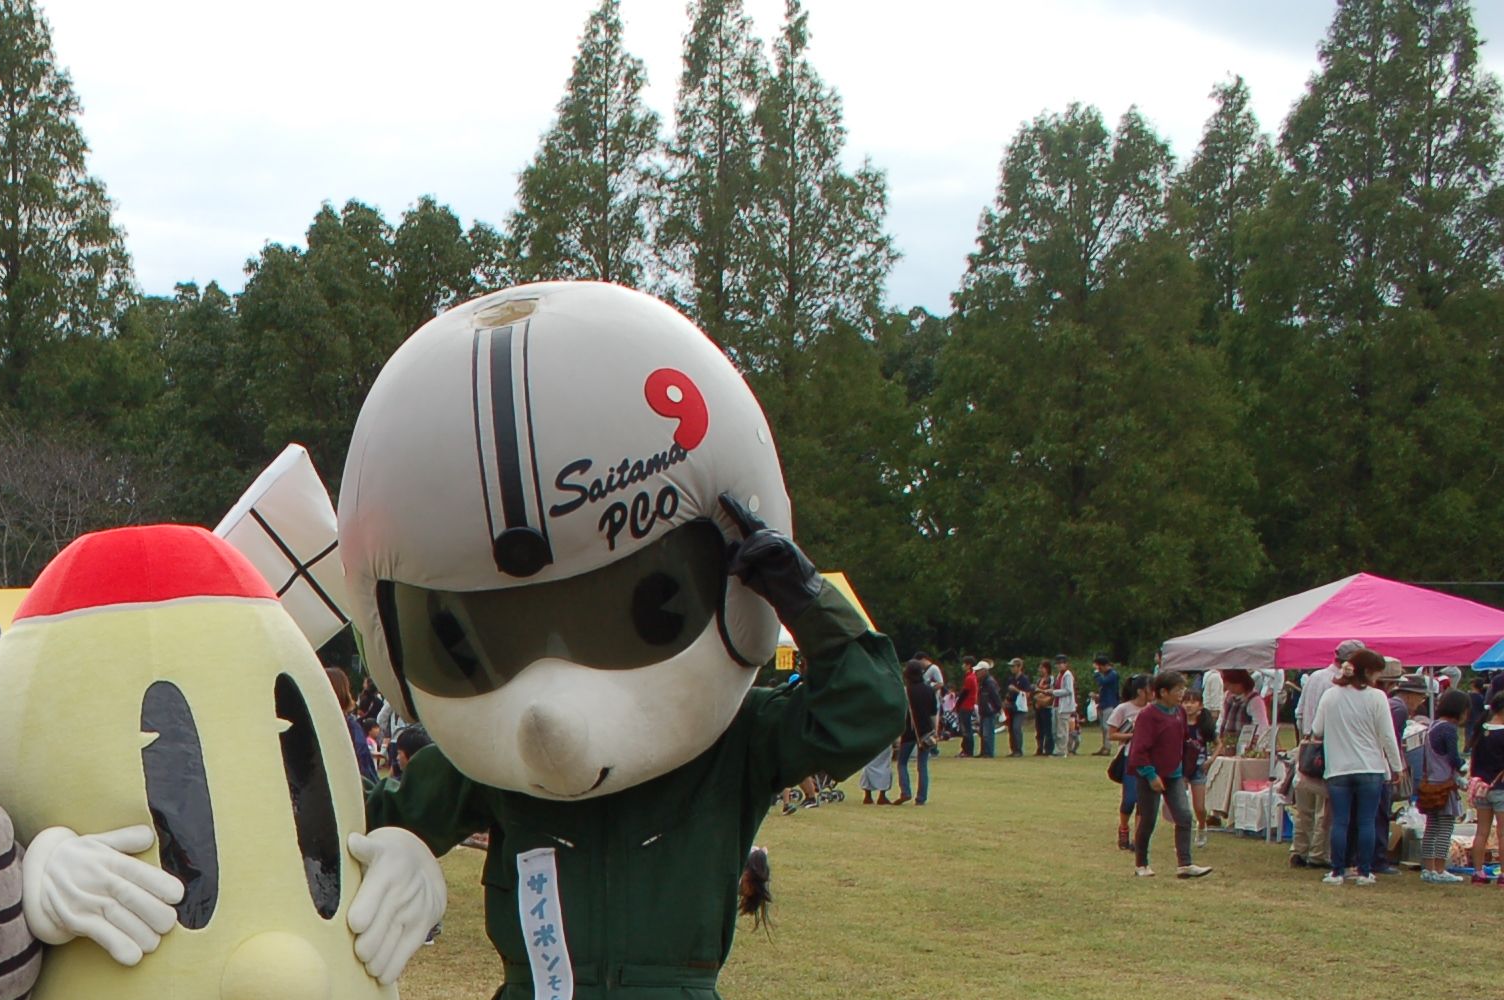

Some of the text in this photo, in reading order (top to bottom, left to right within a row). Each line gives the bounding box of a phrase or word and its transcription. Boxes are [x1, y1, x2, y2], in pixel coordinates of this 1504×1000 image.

[644, 367, 709, 451] 9
[549, 442, 687, 518] Saitama
[599, 486, 679, 551] PCO
